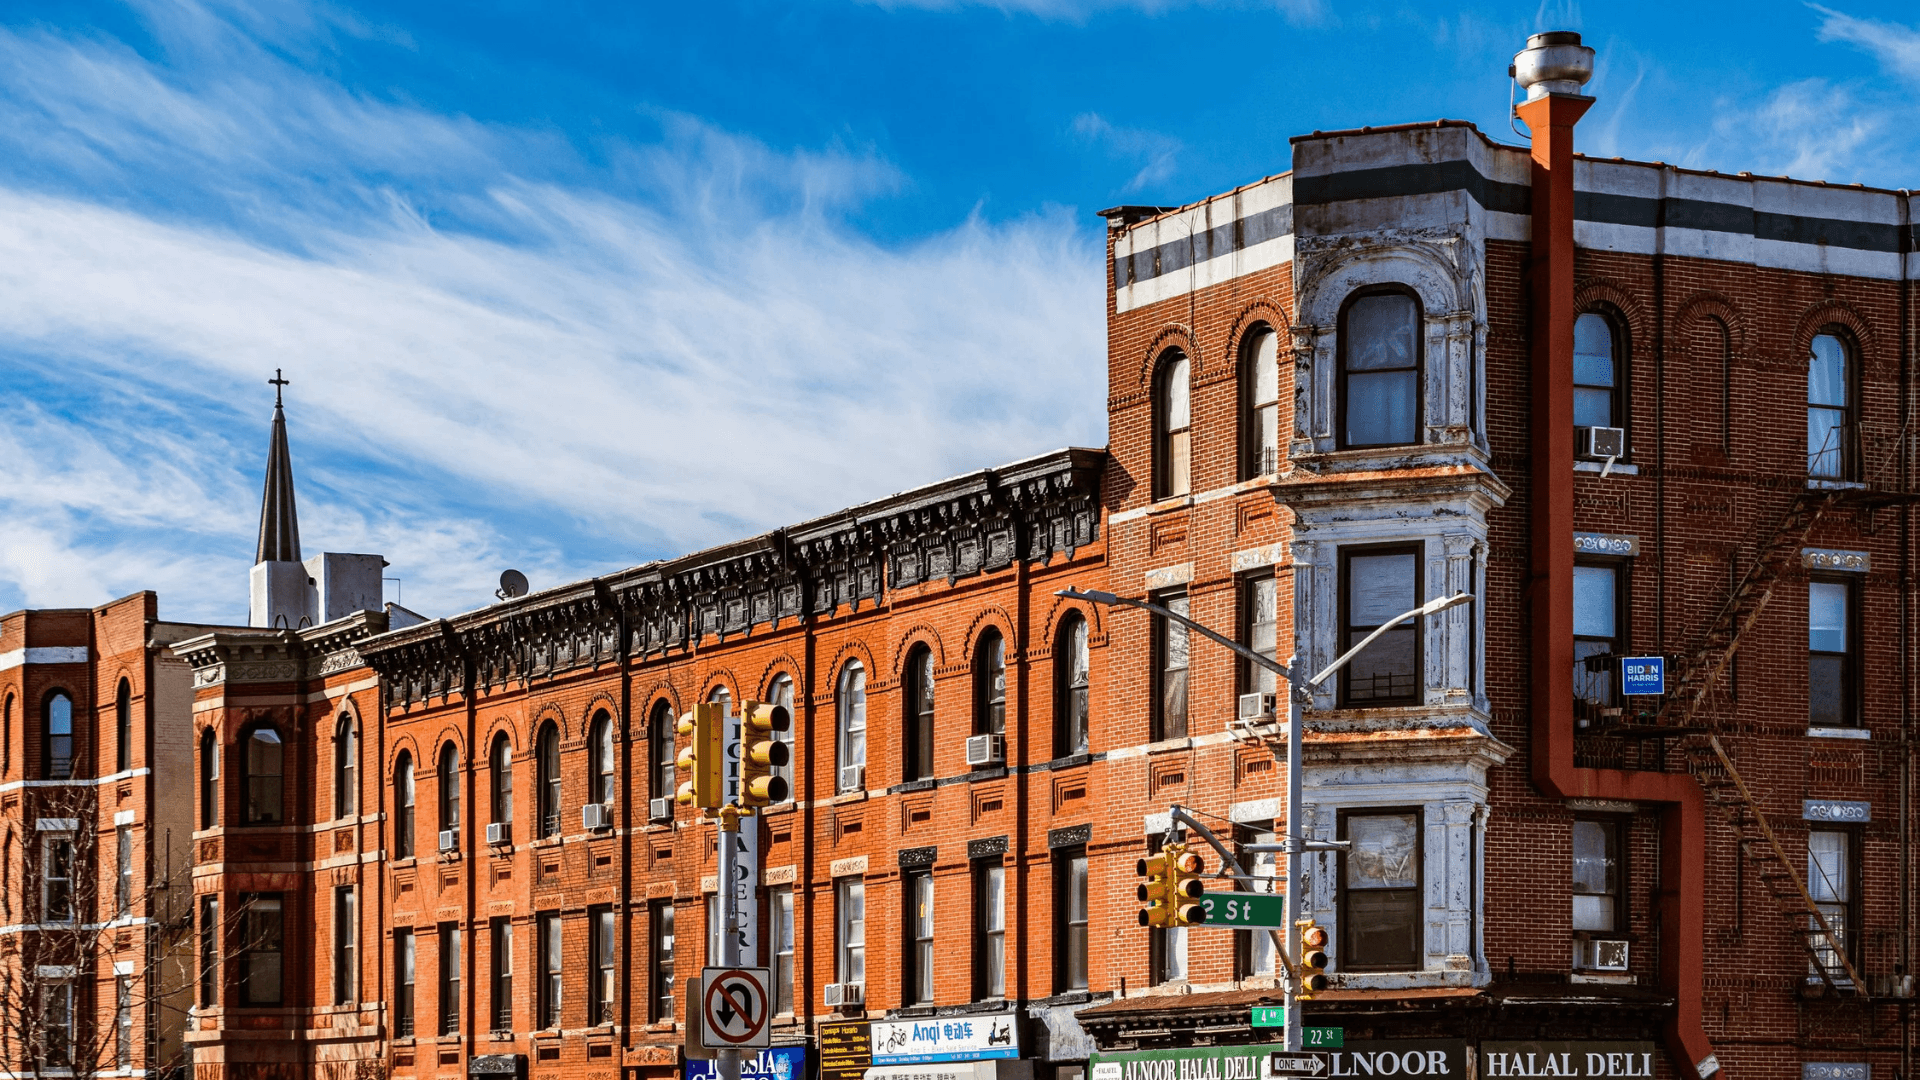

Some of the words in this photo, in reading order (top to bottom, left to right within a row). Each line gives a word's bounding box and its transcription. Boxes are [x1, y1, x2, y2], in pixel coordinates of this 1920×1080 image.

[1627, 665, 1659, 674] BIDEN
[1225, 899, 1252, 920] St
[1261, 1009, 1267, 1023] 4
[912, 1021, 940, 1045] Anqi
[943, 1021, 973, 1041] 电动车
[1310, 1029, 1322, 1045] 22
[1326, 1030, 1334, 1039] St
[1124, 1059, 1176, 1080] ALNOOR
[1179, 1057, 1222, 1080] HALAL
[1224, 1055, 1258, 1080] DELI
[1279, 1059, 1295, 1069] ONE
[1302, 1059, 1319, 1069] WAY
[1330, 1051, 1450, 1077] LNOOR
[1487, 1052, 1578, 1077] HALAL
[1585, 1052, 1651, 1077] DELI
